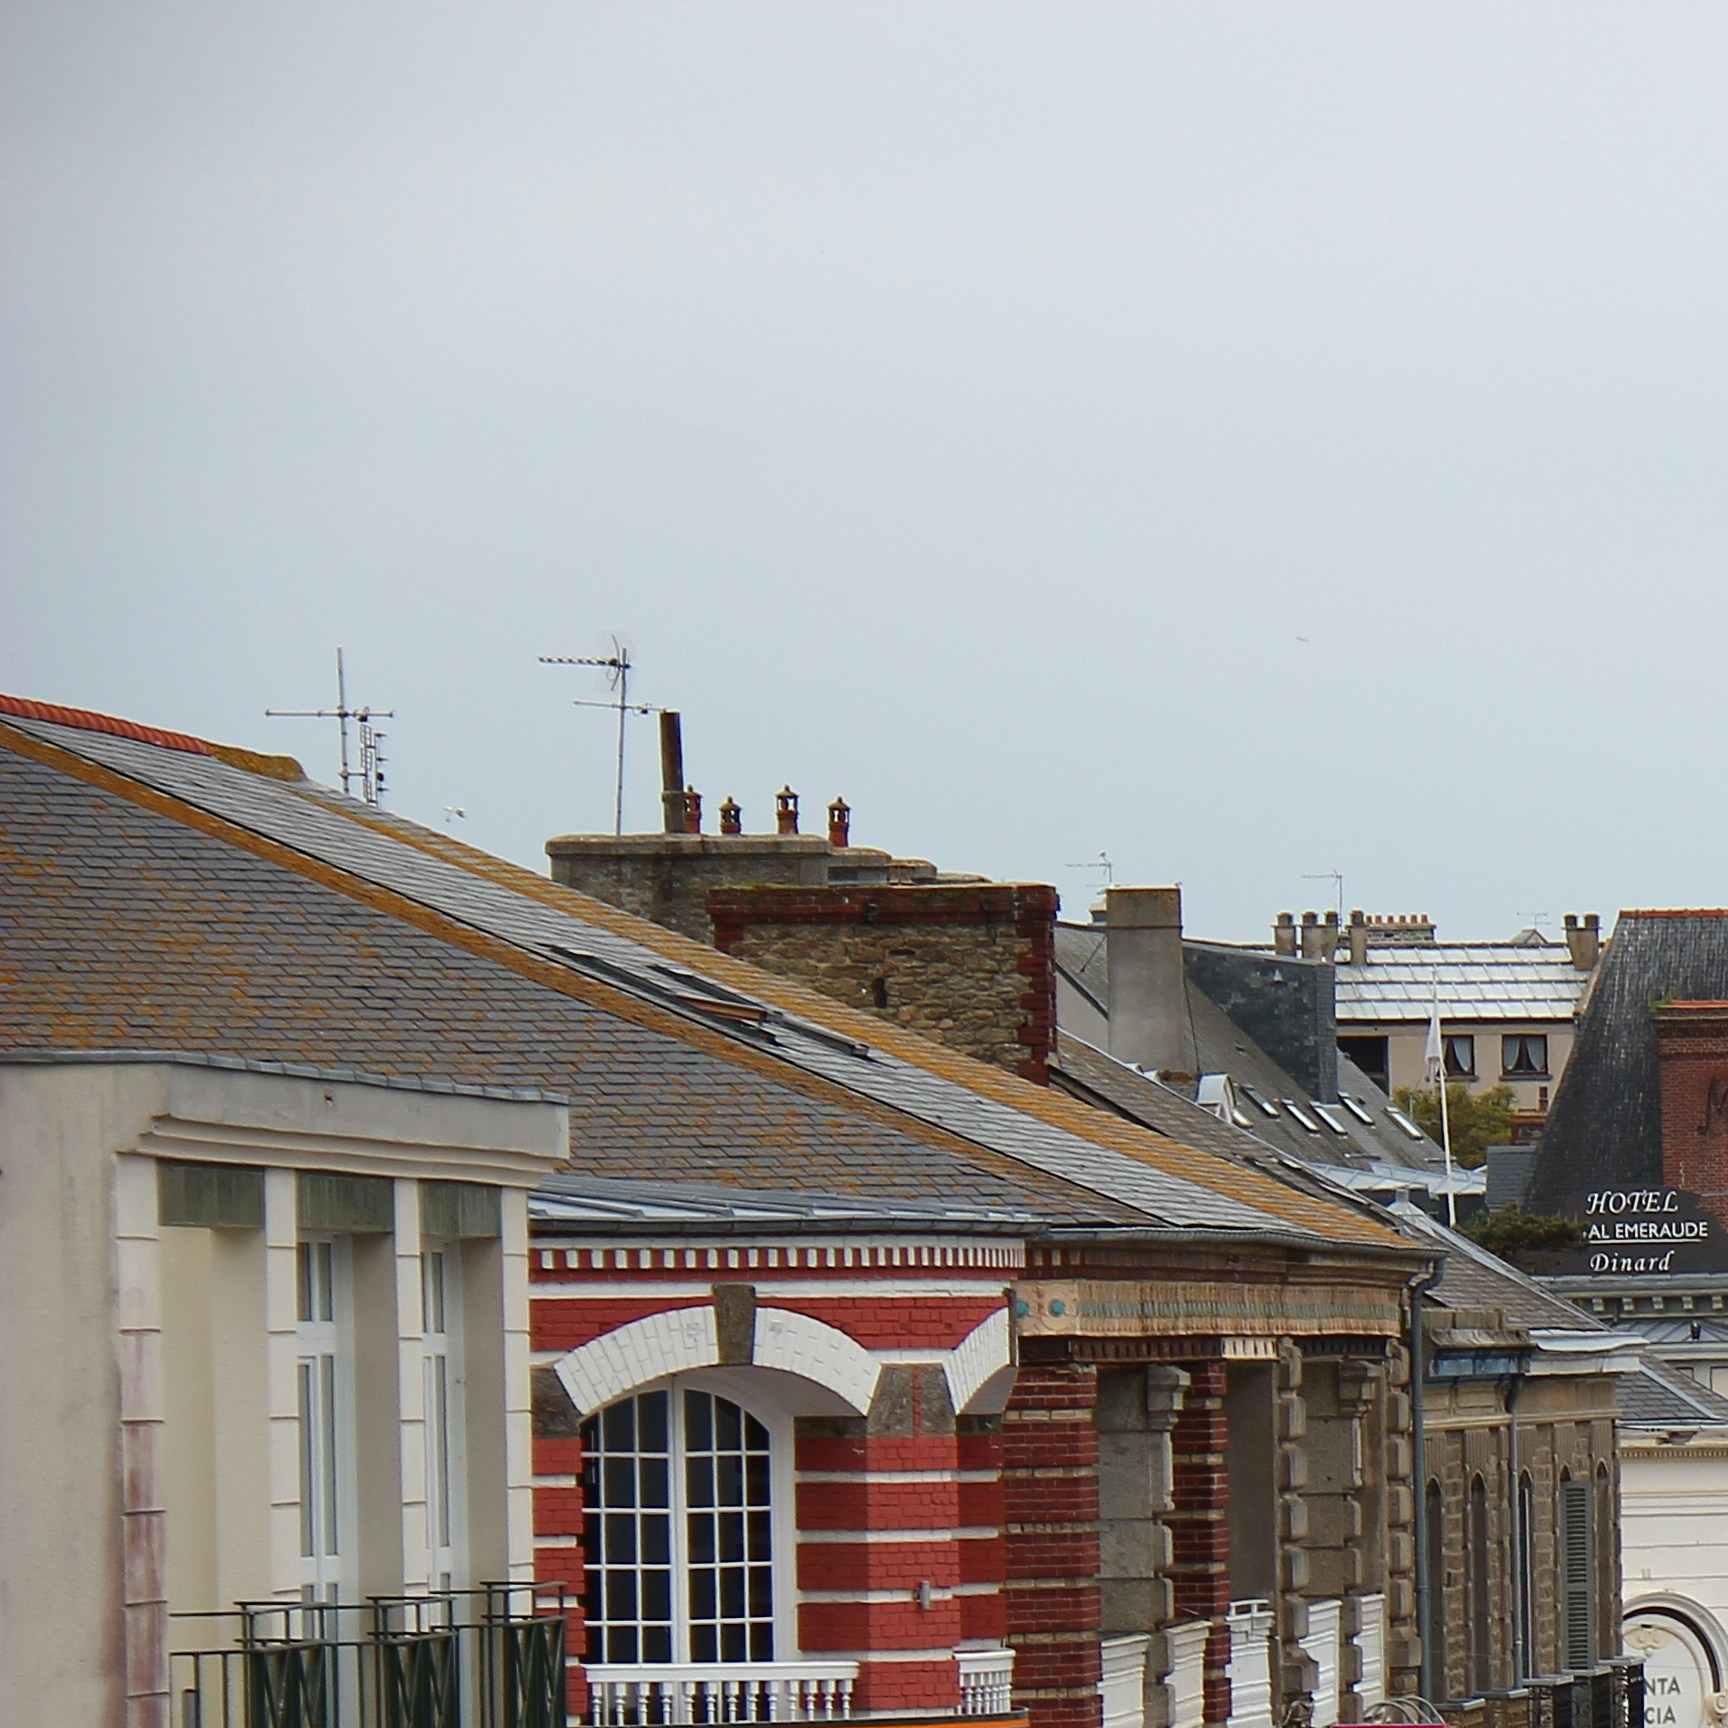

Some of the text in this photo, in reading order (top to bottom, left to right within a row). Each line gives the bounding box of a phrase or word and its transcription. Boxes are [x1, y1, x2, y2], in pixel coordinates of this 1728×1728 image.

[1585, 1190, 1679, 1215] HOTEL
[1615, 1222, 1709, 1238] EMERAUDE
[1589, 1250, 1675, 1272] Dinard
[1643, 1676, 1681, 1696] NTA
[1644, 1705, 1677, 1725] CIA
